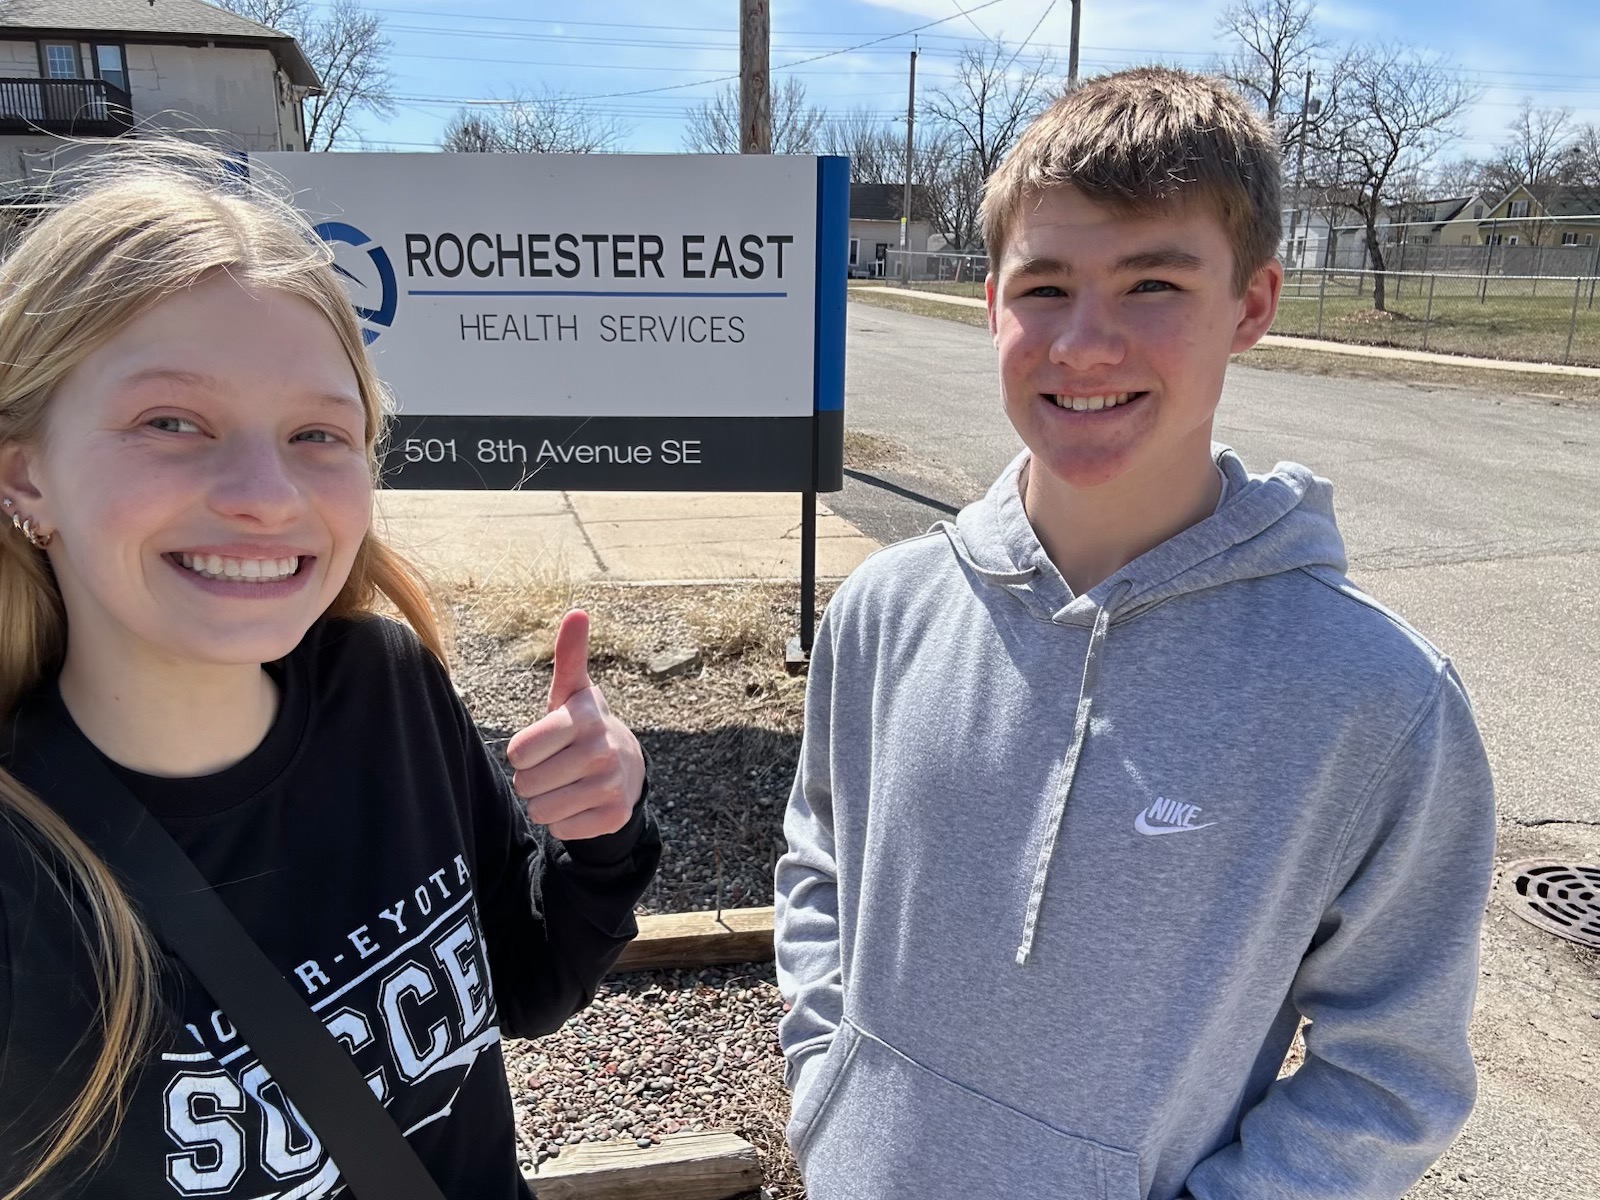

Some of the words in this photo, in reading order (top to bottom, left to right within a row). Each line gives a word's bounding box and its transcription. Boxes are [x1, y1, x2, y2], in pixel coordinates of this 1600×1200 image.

[405, 232, 664, 278] ROCHESTER
[682, 234, 793, 280] EAST
[461, 314, 578, 341] HEALTH
[600, 316, 745, 343] SERVICES
[404, 438, 457, 464] 501
[478, 438, 527, 464] 8th
[536, 438, 652, 464] Avenue
[661, 440, 702, 465] SE
[1147, 796, 1202, 828] NIKE
